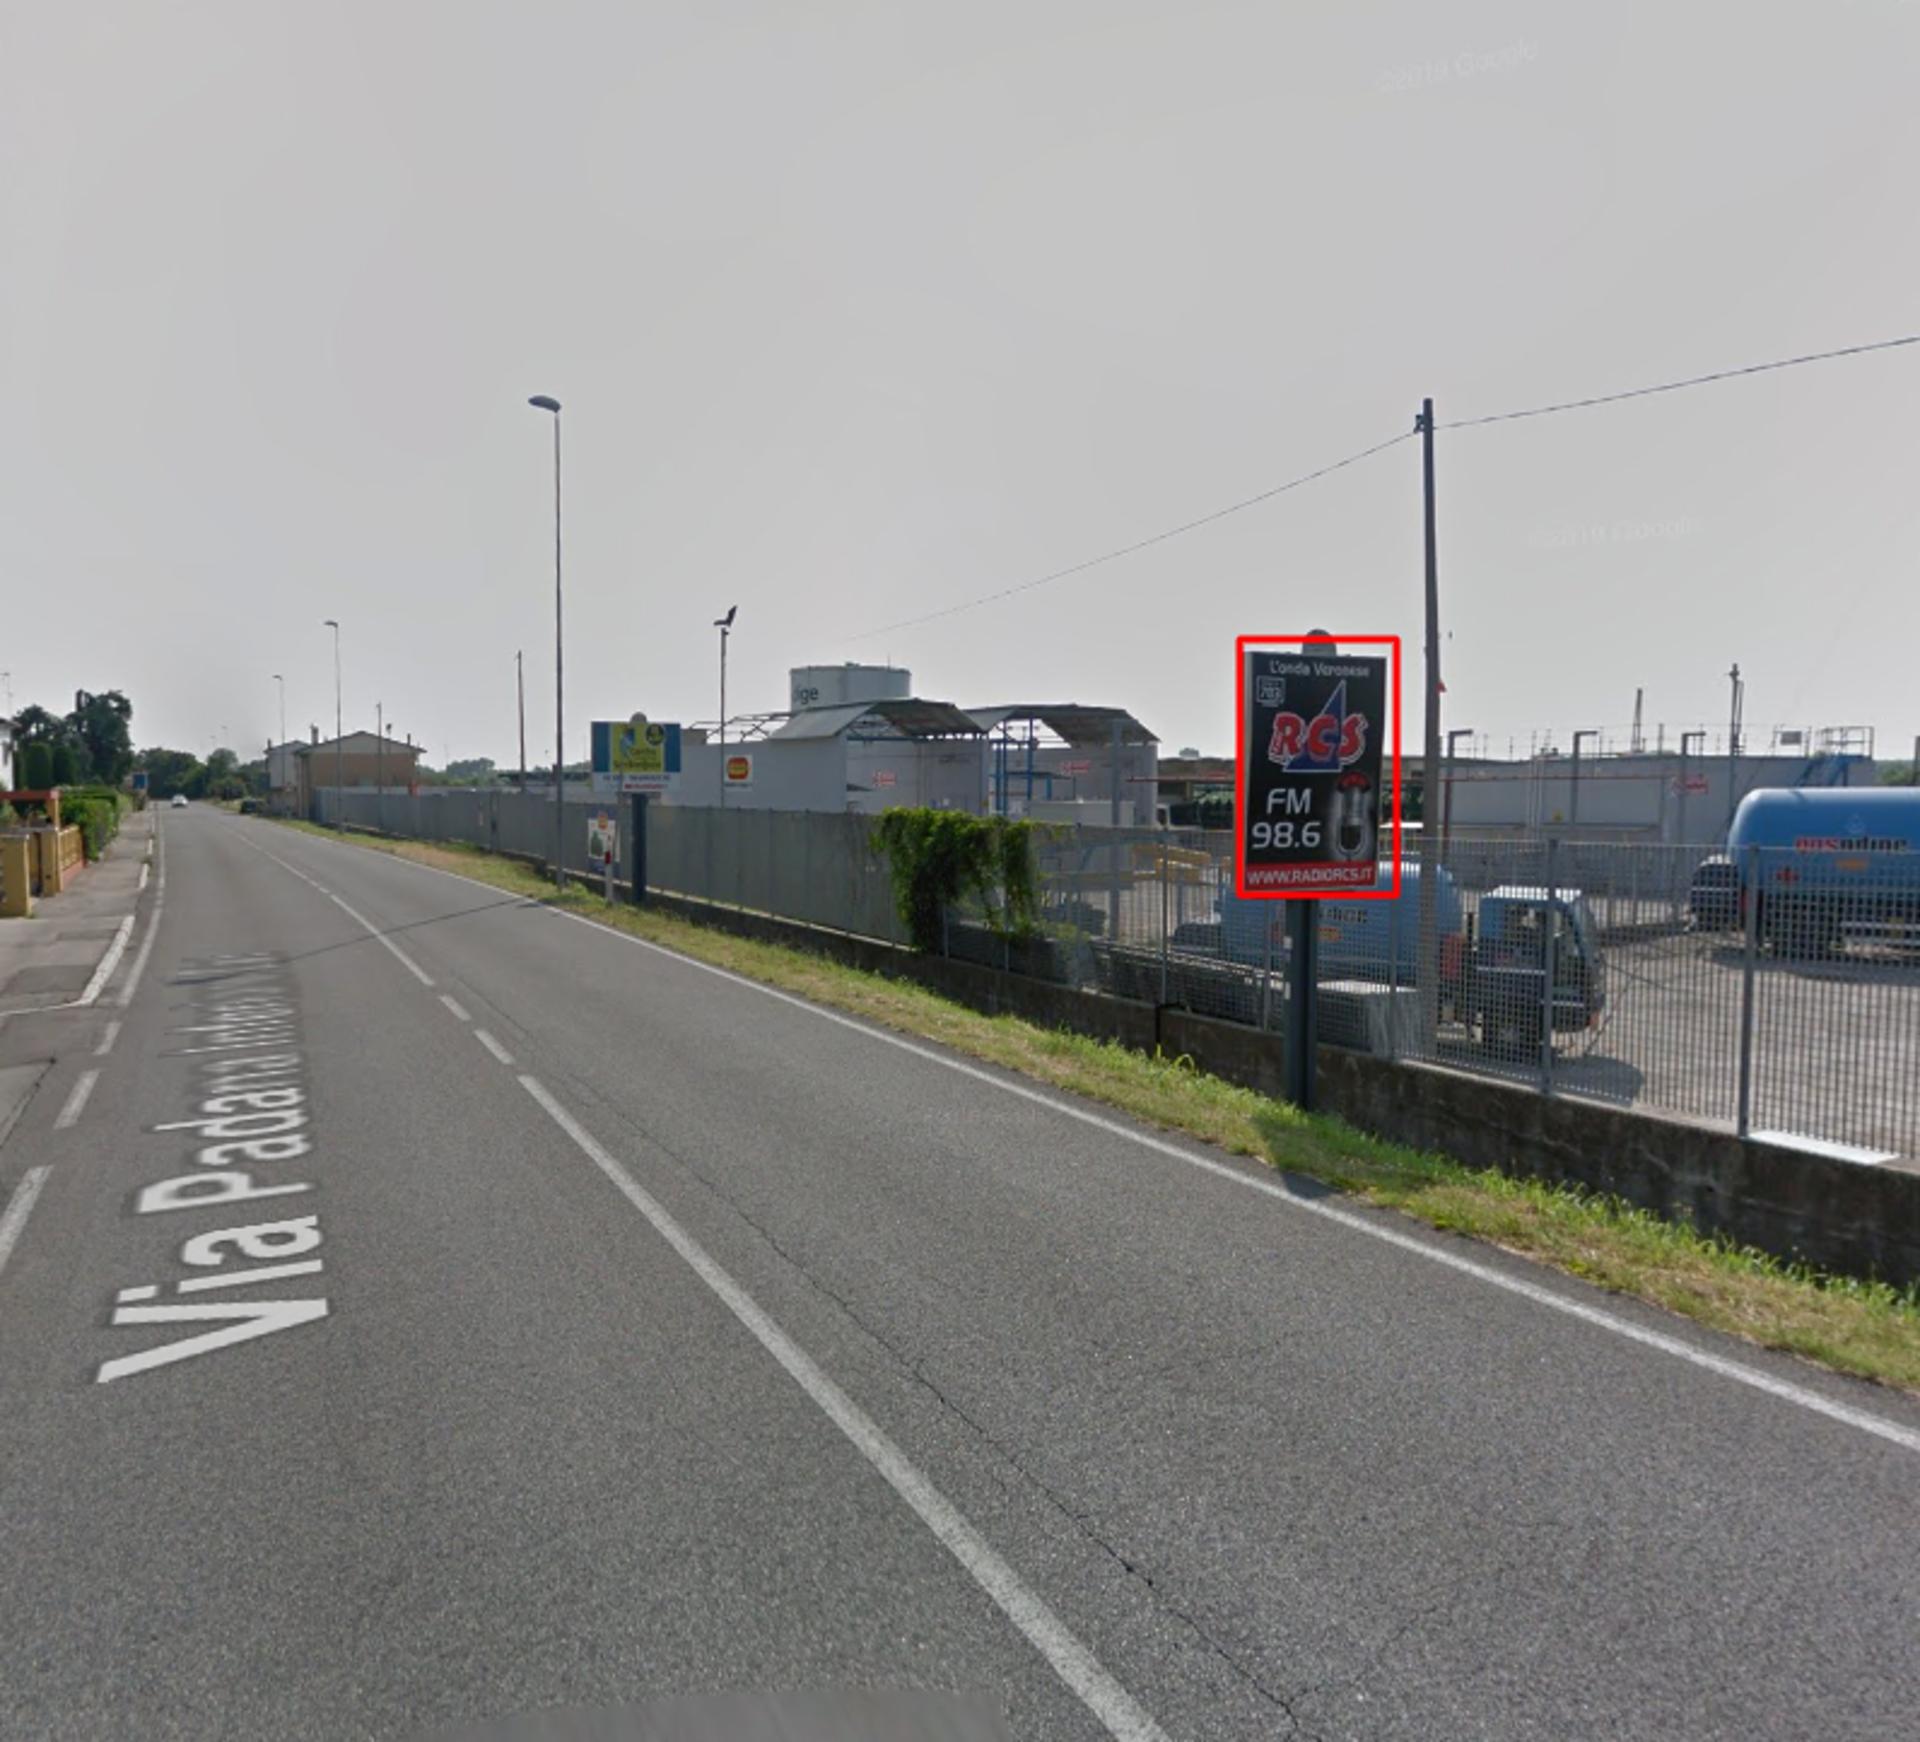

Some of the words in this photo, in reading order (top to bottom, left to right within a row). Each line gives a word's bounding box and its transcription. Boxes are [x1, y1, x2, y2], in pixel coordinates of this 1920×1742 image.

[1268, 711, 1368, 766] RCS
[1266, 788, 1312, 815] FM
[1252, 821, 1321, 848] 98.6
[1246, 866, 1373, 885] WWW.RADIORCS.IT
